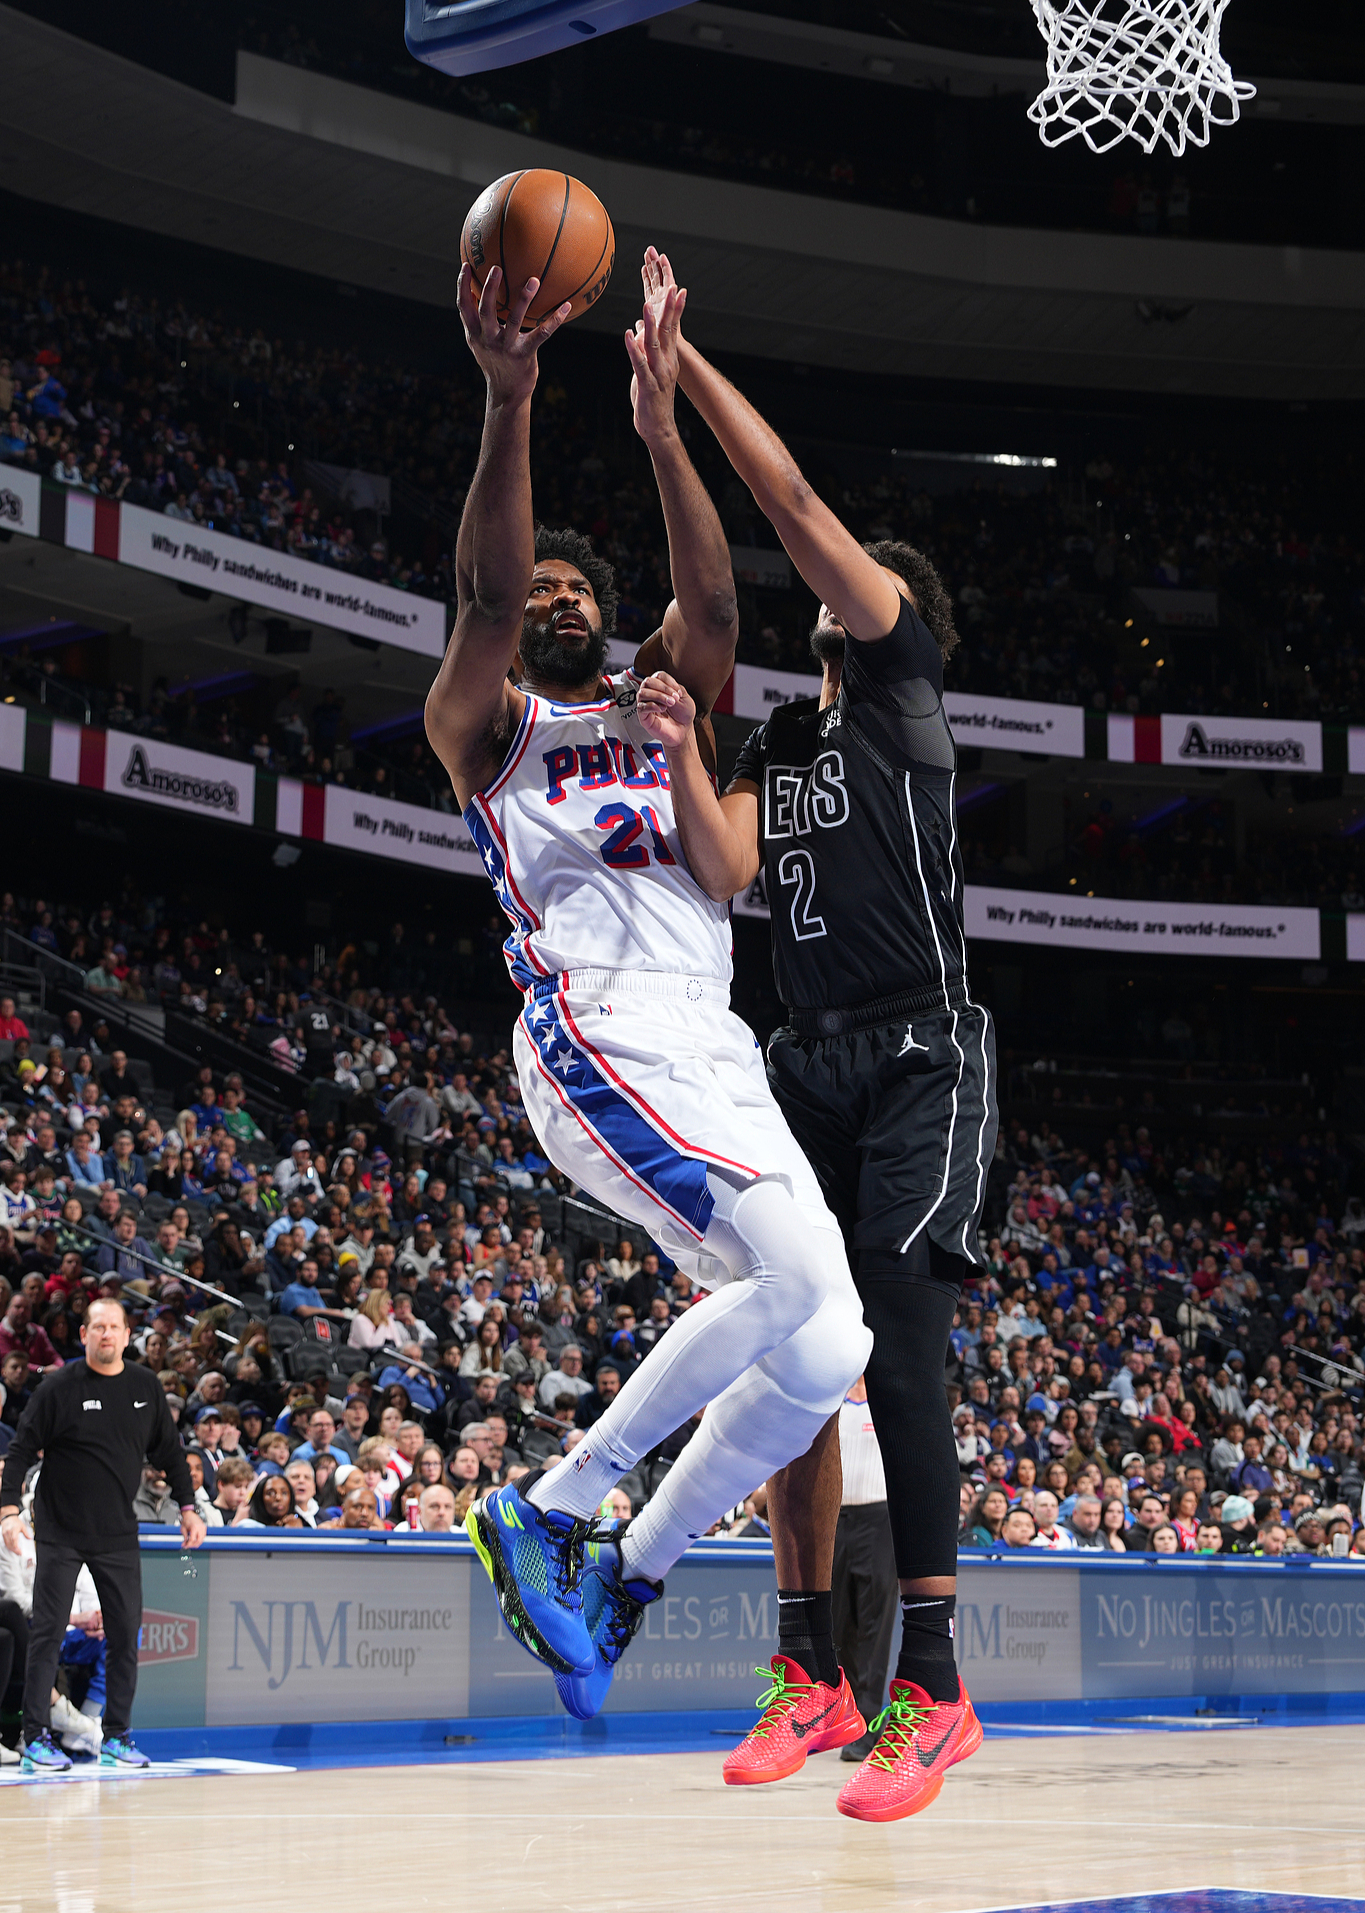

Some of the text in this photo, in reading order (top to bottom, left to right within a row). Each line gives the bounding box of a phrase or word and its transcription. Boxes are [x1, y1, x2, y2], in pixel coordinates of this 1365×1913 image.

[151, 532, 179, 558] Why
[182, 543, 219, 571] Philly
[223, 560, 298, 593] sandwiches
[301, 583, 321, 600] are
[763, 687, 790, 704] Why
[1181, 724, 1302, 761] Amoroso's
[124, 747, 237, 809] Amoroso's
[353, 811, 378, 835] Why
[382, 817, 414, 844] Philly
[593, 801, 677, 869] 21
[778, 849, 828, 942] 2
[987, 905, 1015, 925] Why
[1018, 908, 1056, 929] Philly
[1060, 915, 1139, 933] sandwiches
[1143, 922, 1167, 935] are
[310, 1012, 330, 1030] 21
[357, 1602, 452, 1630] Insurance
[709, 1606, 739, 1628] OR
[1006, 1605, 1069, 1628] Insurance
[1096, 1594, 1136, 1638] NO
[1138, 1594, 1237, 1648] JINGLES
[1260, 1596, 1365, 1638] MASCOTS
[140, 1620, 190, 1654] ERR'S
[227, 1600, 353, 1690] NJM
[956, 1603, 1004, 1669] JM
[613, 1662, 645, 1681] UST
[651, 1661, 702, 1680] GREAT
[1169, 1653, 1304, 1671] JUST GREAT INSURANCE
